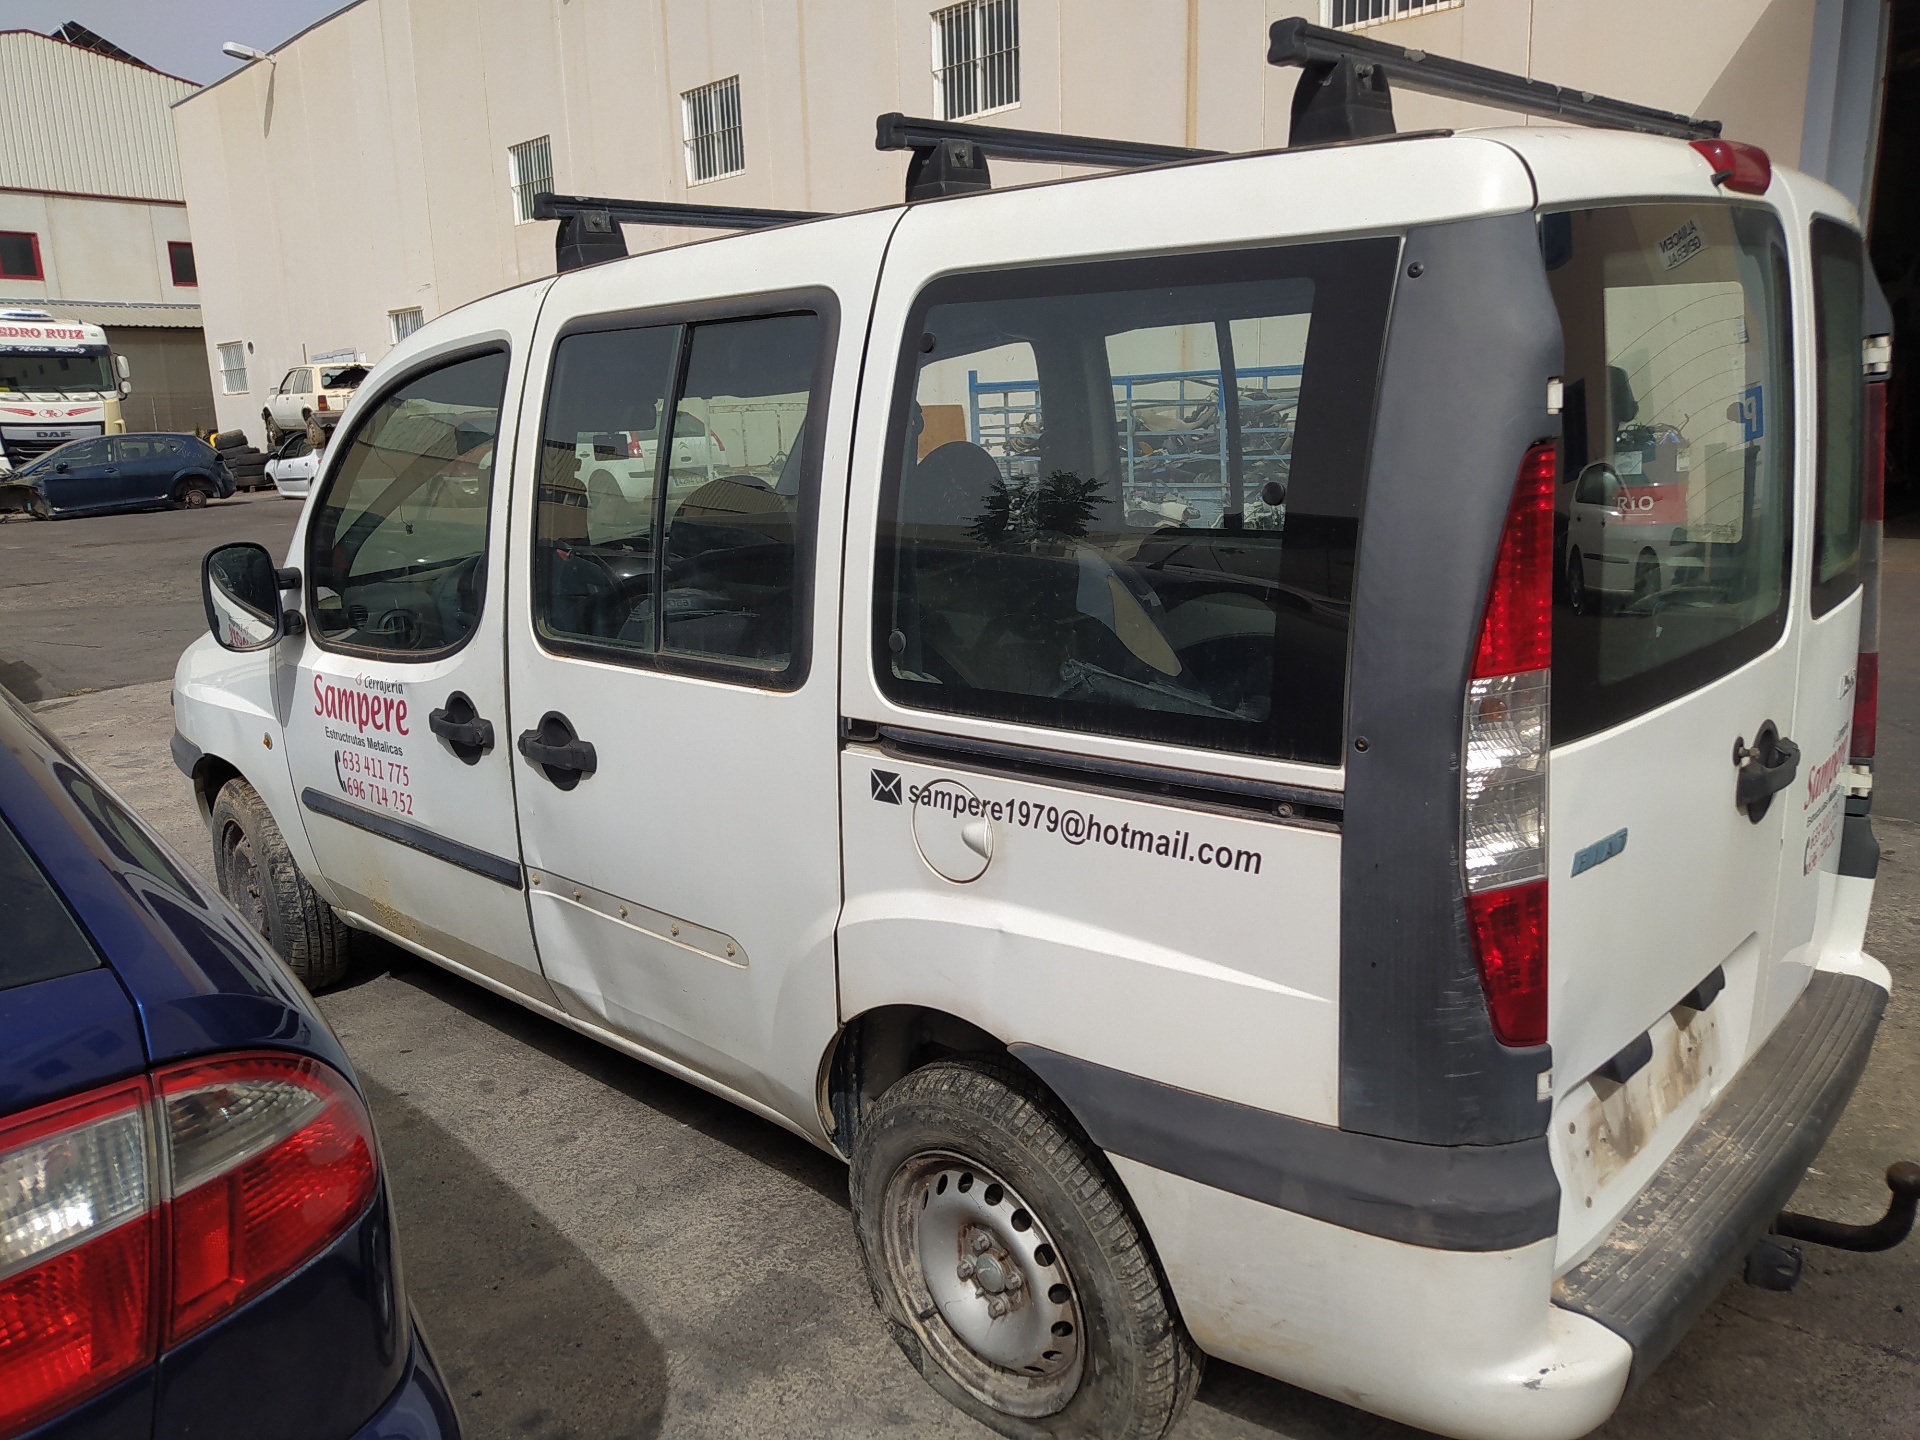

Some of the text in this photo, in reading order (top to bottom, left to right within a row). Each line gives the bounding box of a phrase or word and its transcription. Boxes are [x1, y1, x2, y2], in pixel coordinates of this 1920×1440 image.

[44, 328, 85, 340] RUIZ
[364, 675, 404, 695] Cerrajería
[313, 674, 409, 736] Sampere
[342, 750, 410, 787] 633 411 775
[347, 776, 366, 801] 696
[368, 782, 389, 808] 714
[907, 783, 1262, 875] sampere1979@hotmail.com
